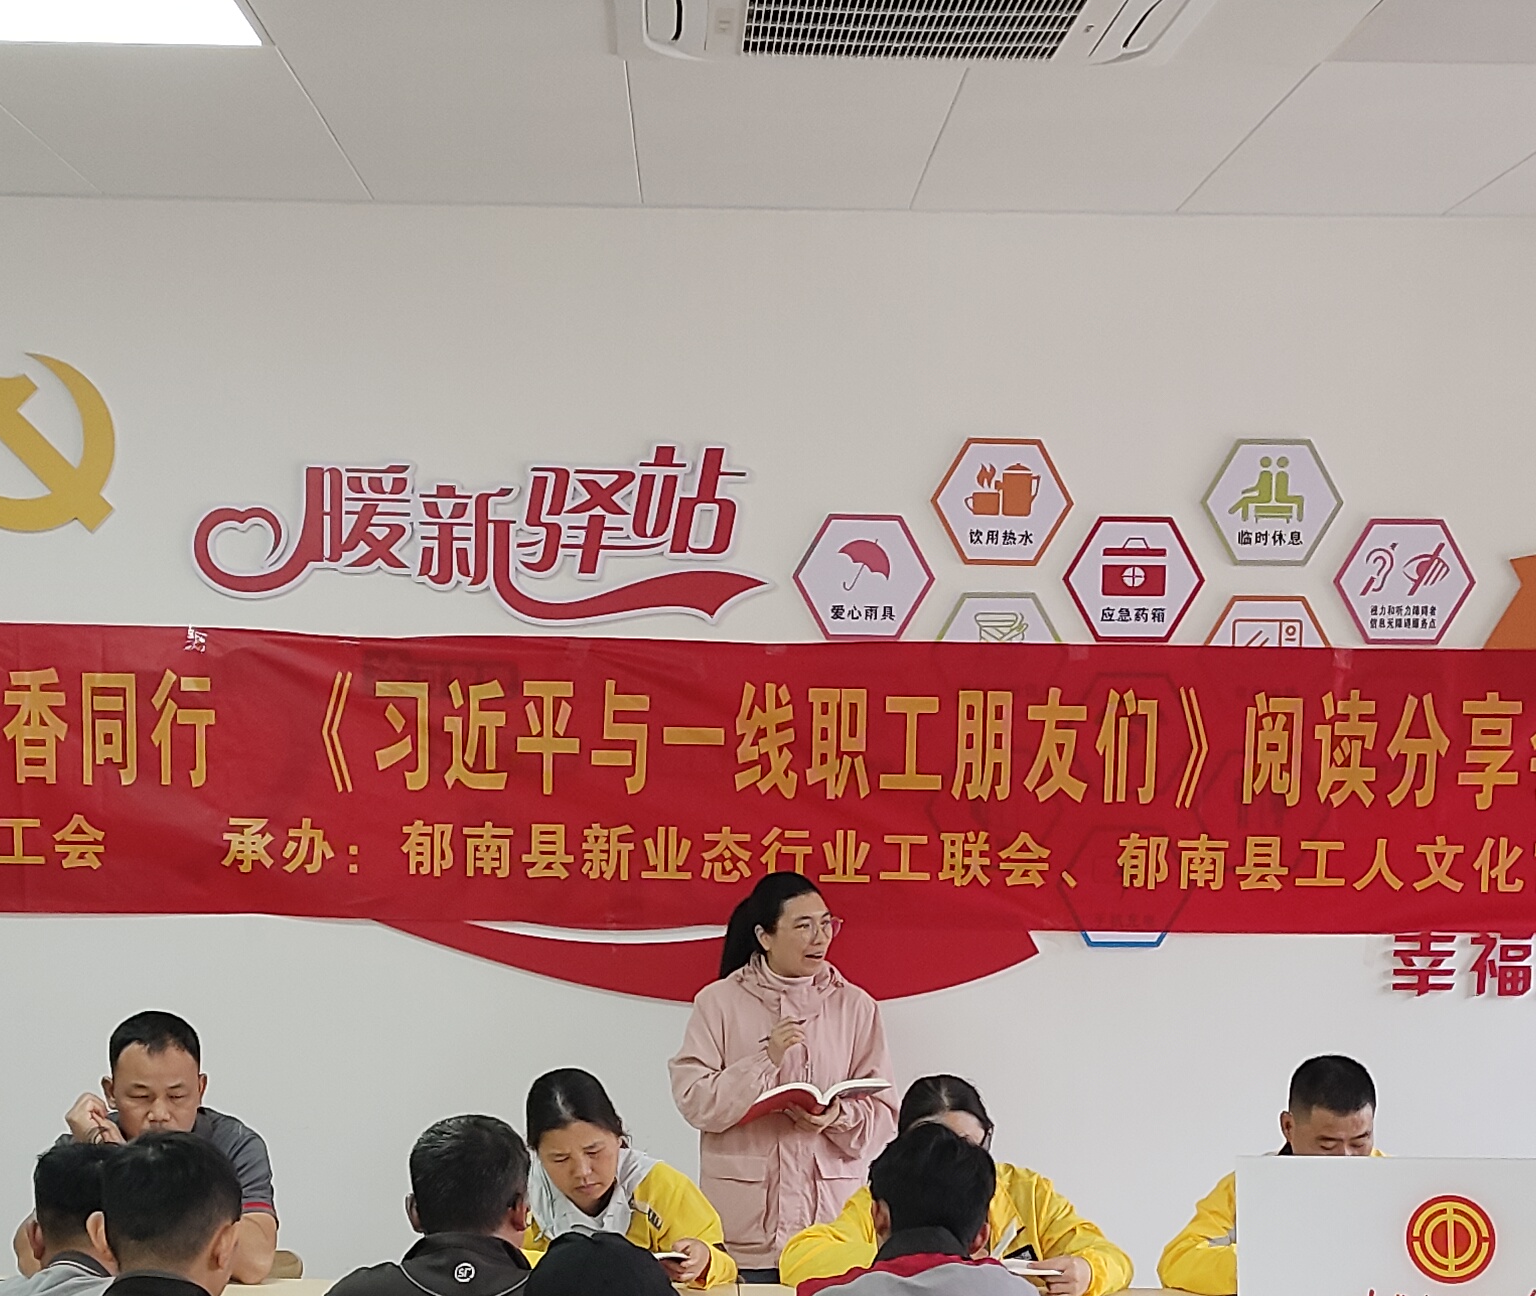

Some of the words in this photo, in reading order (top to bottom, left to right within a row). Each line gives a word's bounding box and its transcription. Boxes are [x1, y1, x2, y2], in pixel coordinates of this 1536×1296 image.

[254, 446, 754, 602] 暖新驿站
[969, 528, 1035, 547] 饮用热水
[1237, 529, 1304, 547] 临时休息
[830, 604, 897, 622] 爱心雨具
[1100, 606, 1167, 624] 应急药箱
